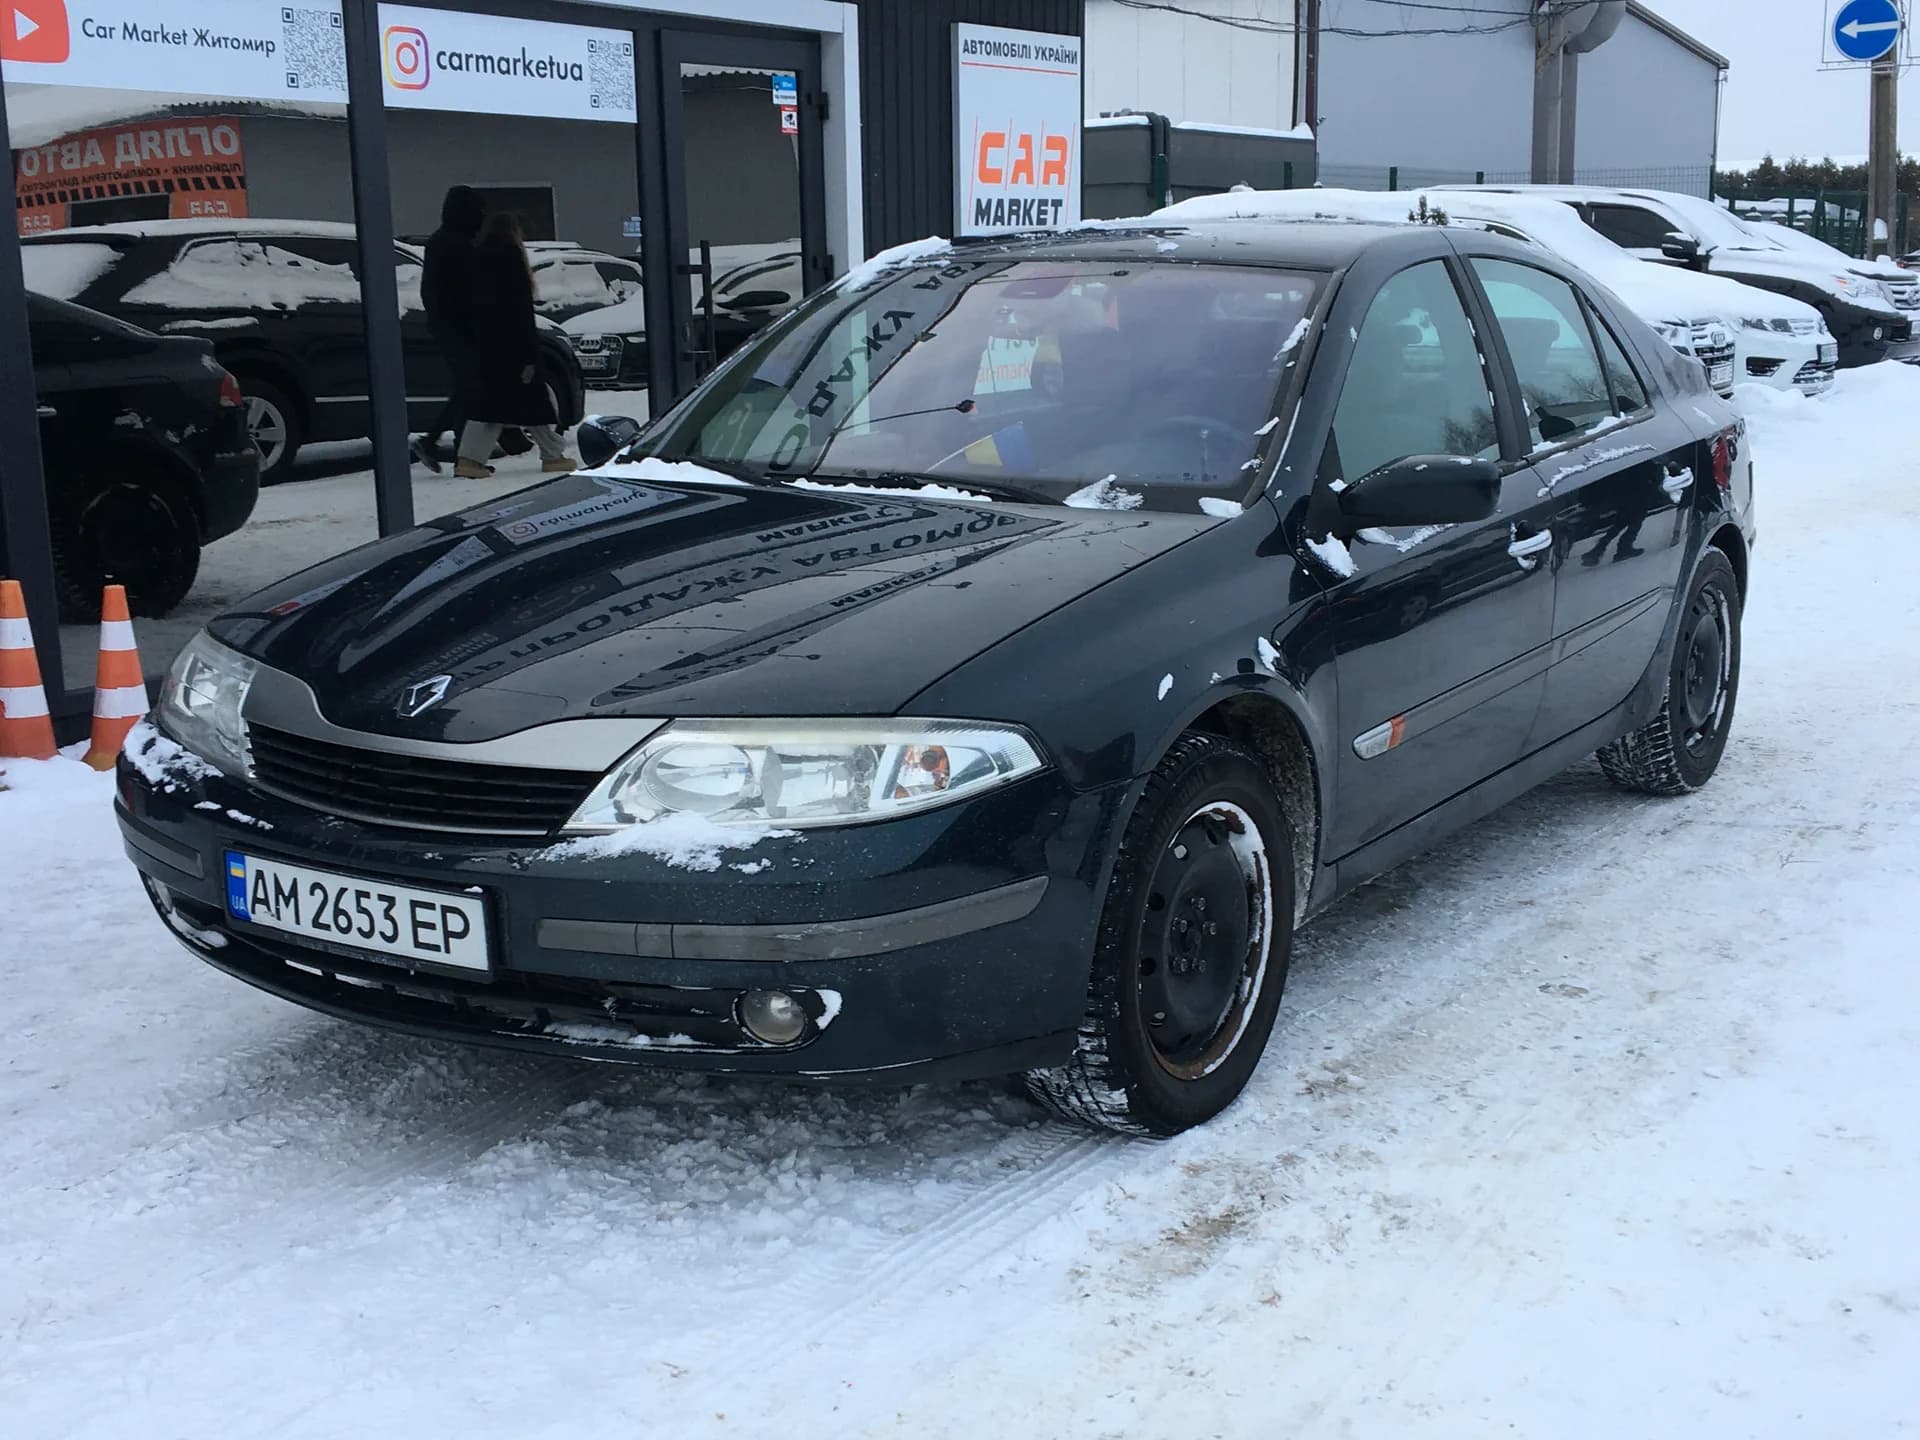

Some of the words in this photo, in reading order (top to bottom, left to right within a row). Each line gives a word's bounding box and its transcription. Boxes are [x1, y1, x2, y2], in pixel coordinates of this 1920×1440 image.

[81, 18, 116, 40] Car
[123, 22, 188, 46] Market
[193, 28, 276, 58] Житомир
[962, 38, 1032, 60] АВТОМОБІЛІ
[1034, 45, 1078, 65] УКРАЇНИ
[436, 47, 583, 82] carmarketua
[978, 131, 1068, 186] CAR
[974, 198, 1063, 226] MARKET
[232, 895, 247, 911] UA
[250, 868, 301, 926] AM
[309, 881, 399, 944] 2653
[409, 899, 470, 954] EP
